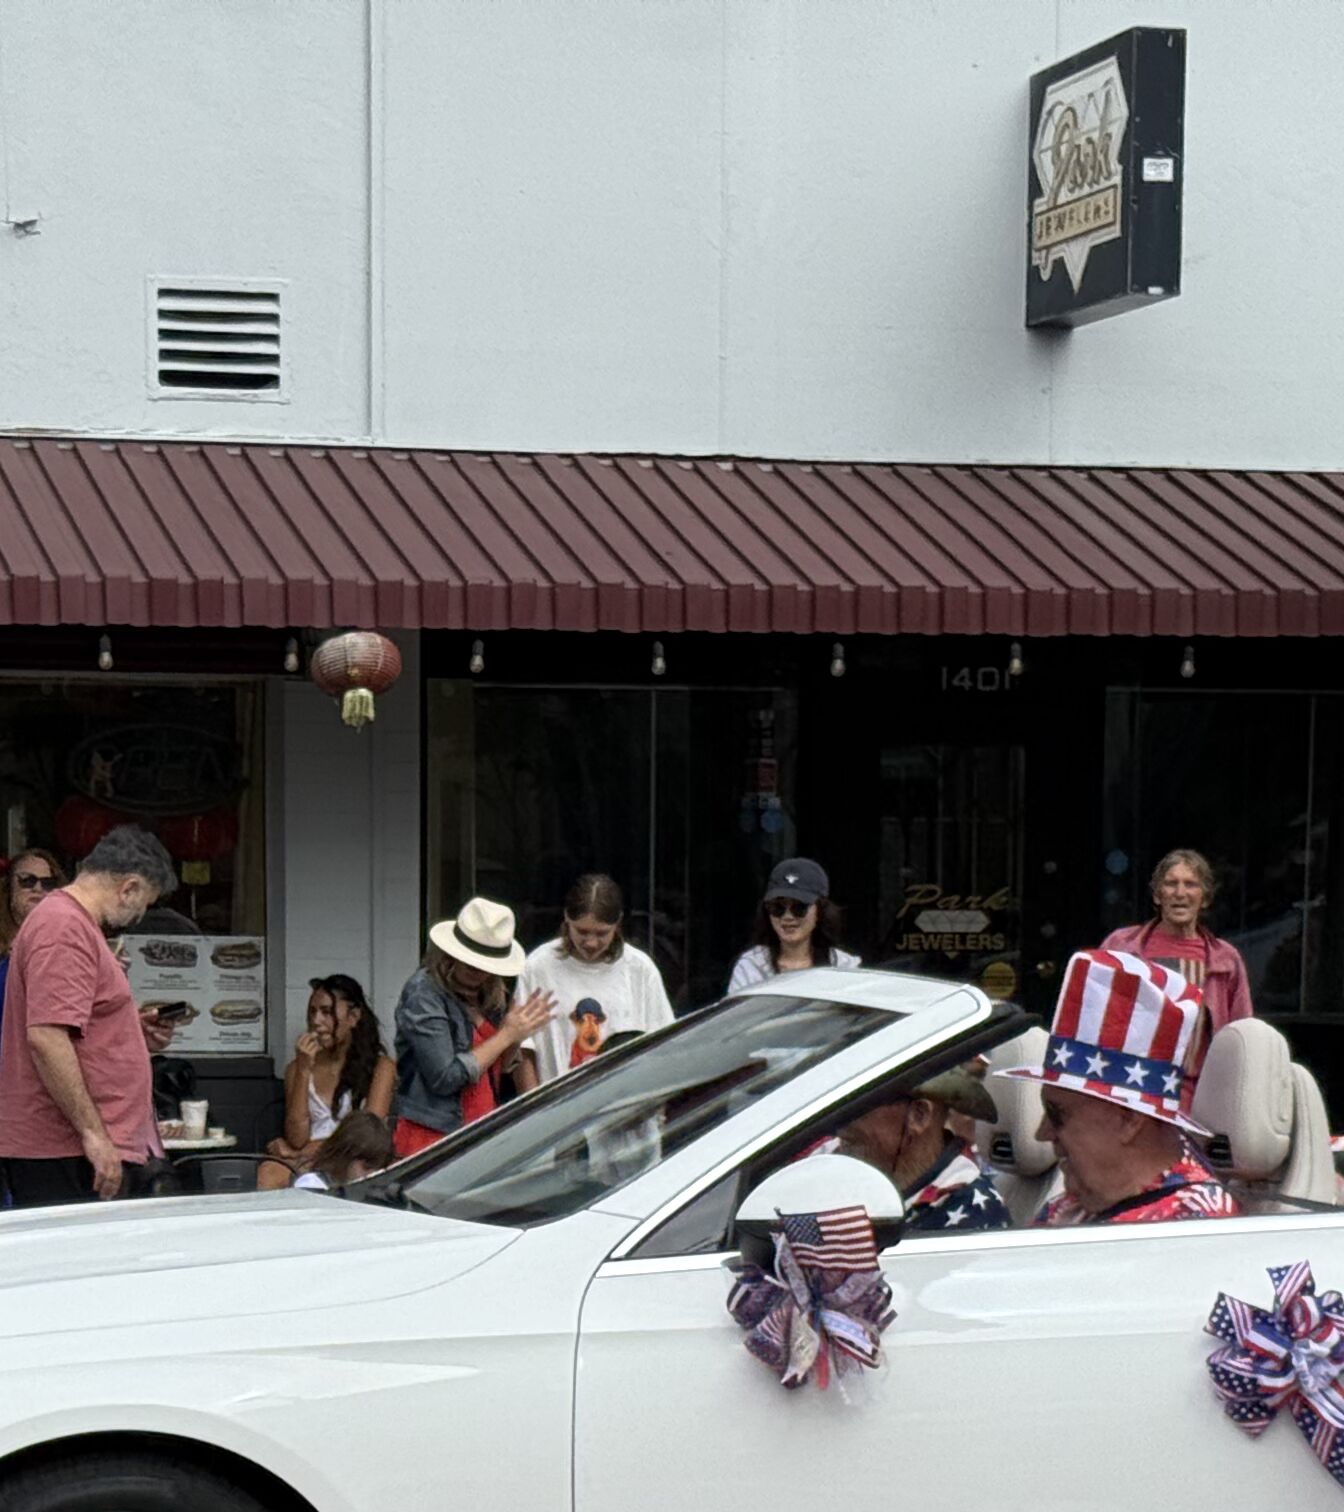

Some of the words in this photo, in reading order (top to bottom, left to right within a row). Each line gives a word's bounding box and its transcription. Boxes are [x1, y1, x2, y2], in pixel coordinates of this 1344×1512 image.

[1037, 201, 1111, 241] JEWELERS
[940, 665, 1012, 692] 1401
[896, 883, 1011, 919] Park
[896, 934, 1006, 951] JEWELERS
